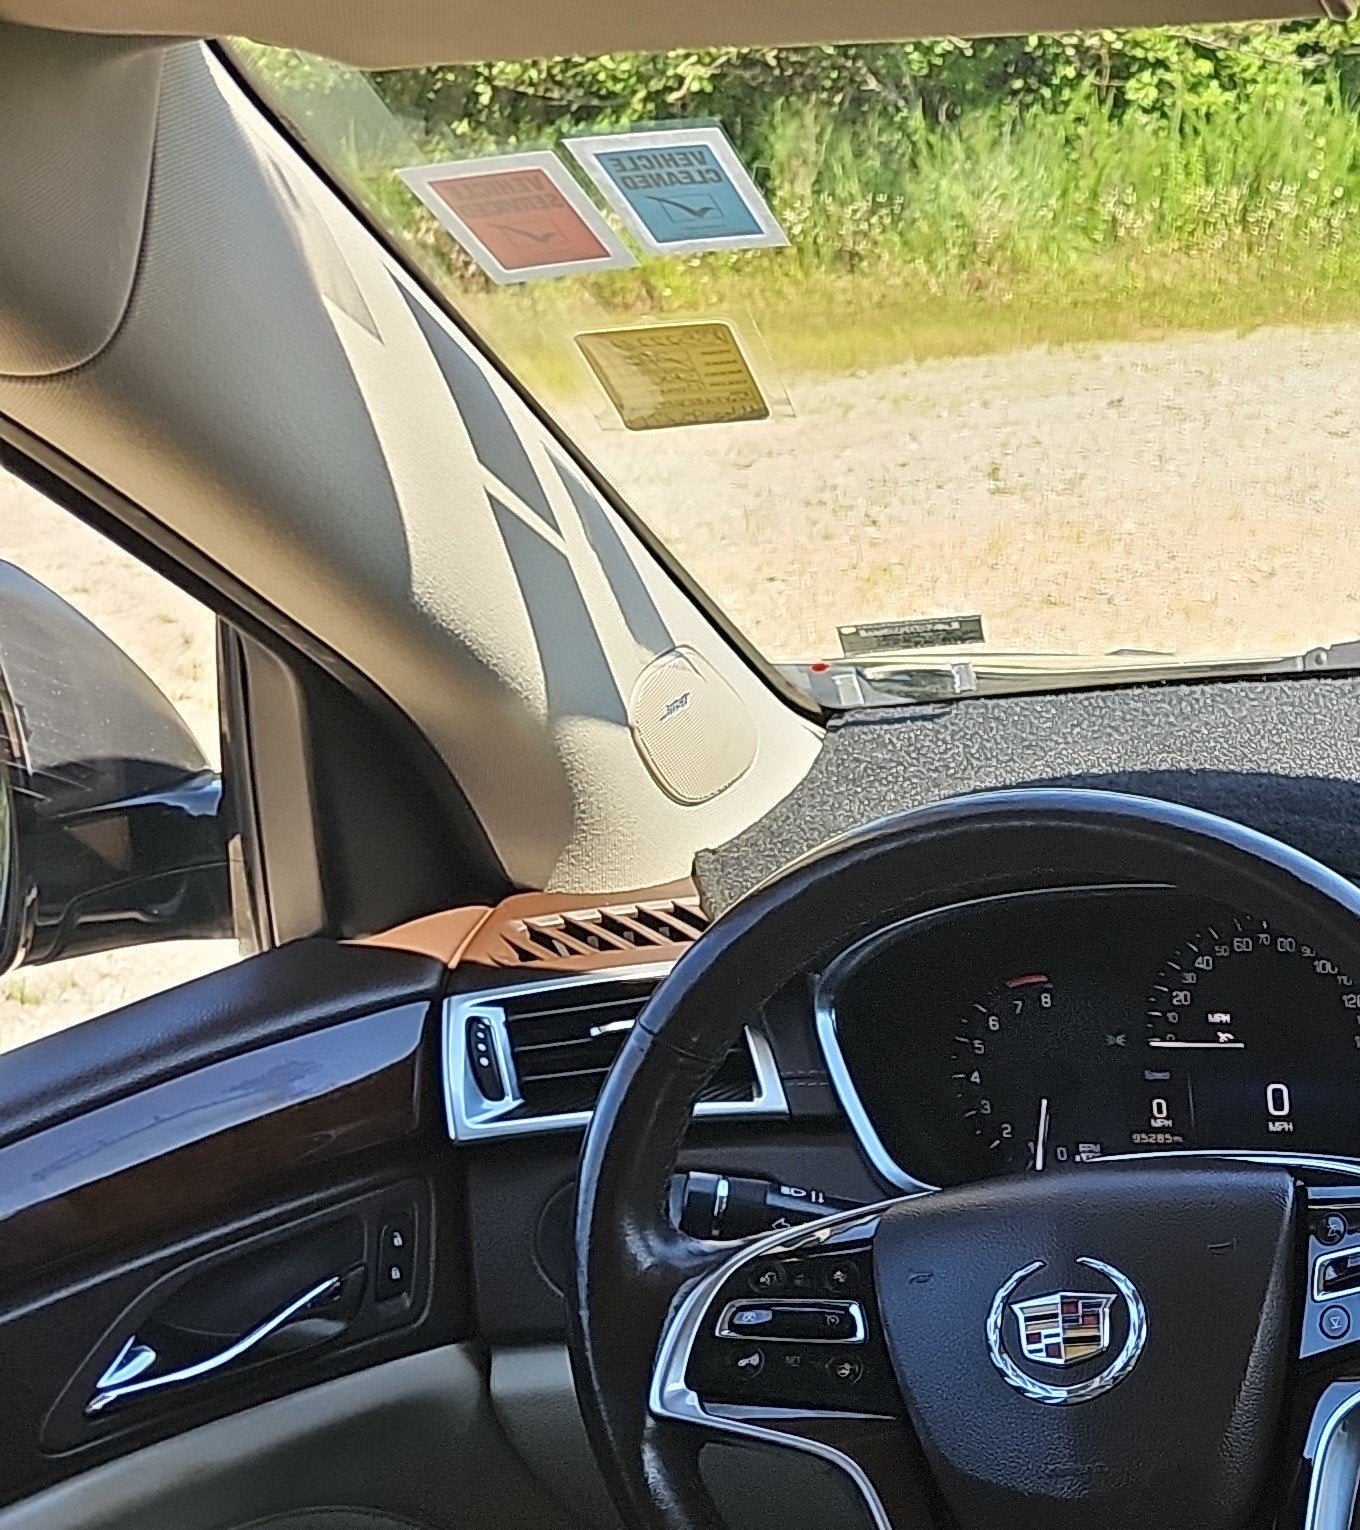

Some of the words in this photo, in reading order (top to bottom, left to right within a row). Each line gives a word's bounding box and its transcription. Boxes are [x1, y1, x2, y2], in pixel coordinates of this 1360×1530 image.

[1233, 938, 1253, 952] 60
[1195, 956, 1213, 970] 40
[1041, 993, 1051, 1007] 8
[1172, 991, 1191, 1005] 20
[1013, 1000, 1023, 1014] 7
[988, 1016, 1000, 1030] 6
[973, 1040, 985, 1054] 5
[970, 1071, 981, 1084] 4
[1266, 1083, 1290, 1116] 0
[981, 1100, 991, 1114] 3
[1152, 1098, 1167, 1118] 0
[1001, 1123, 1012, 1137] 2
[1057, 1147, 1067, 1161] 0
